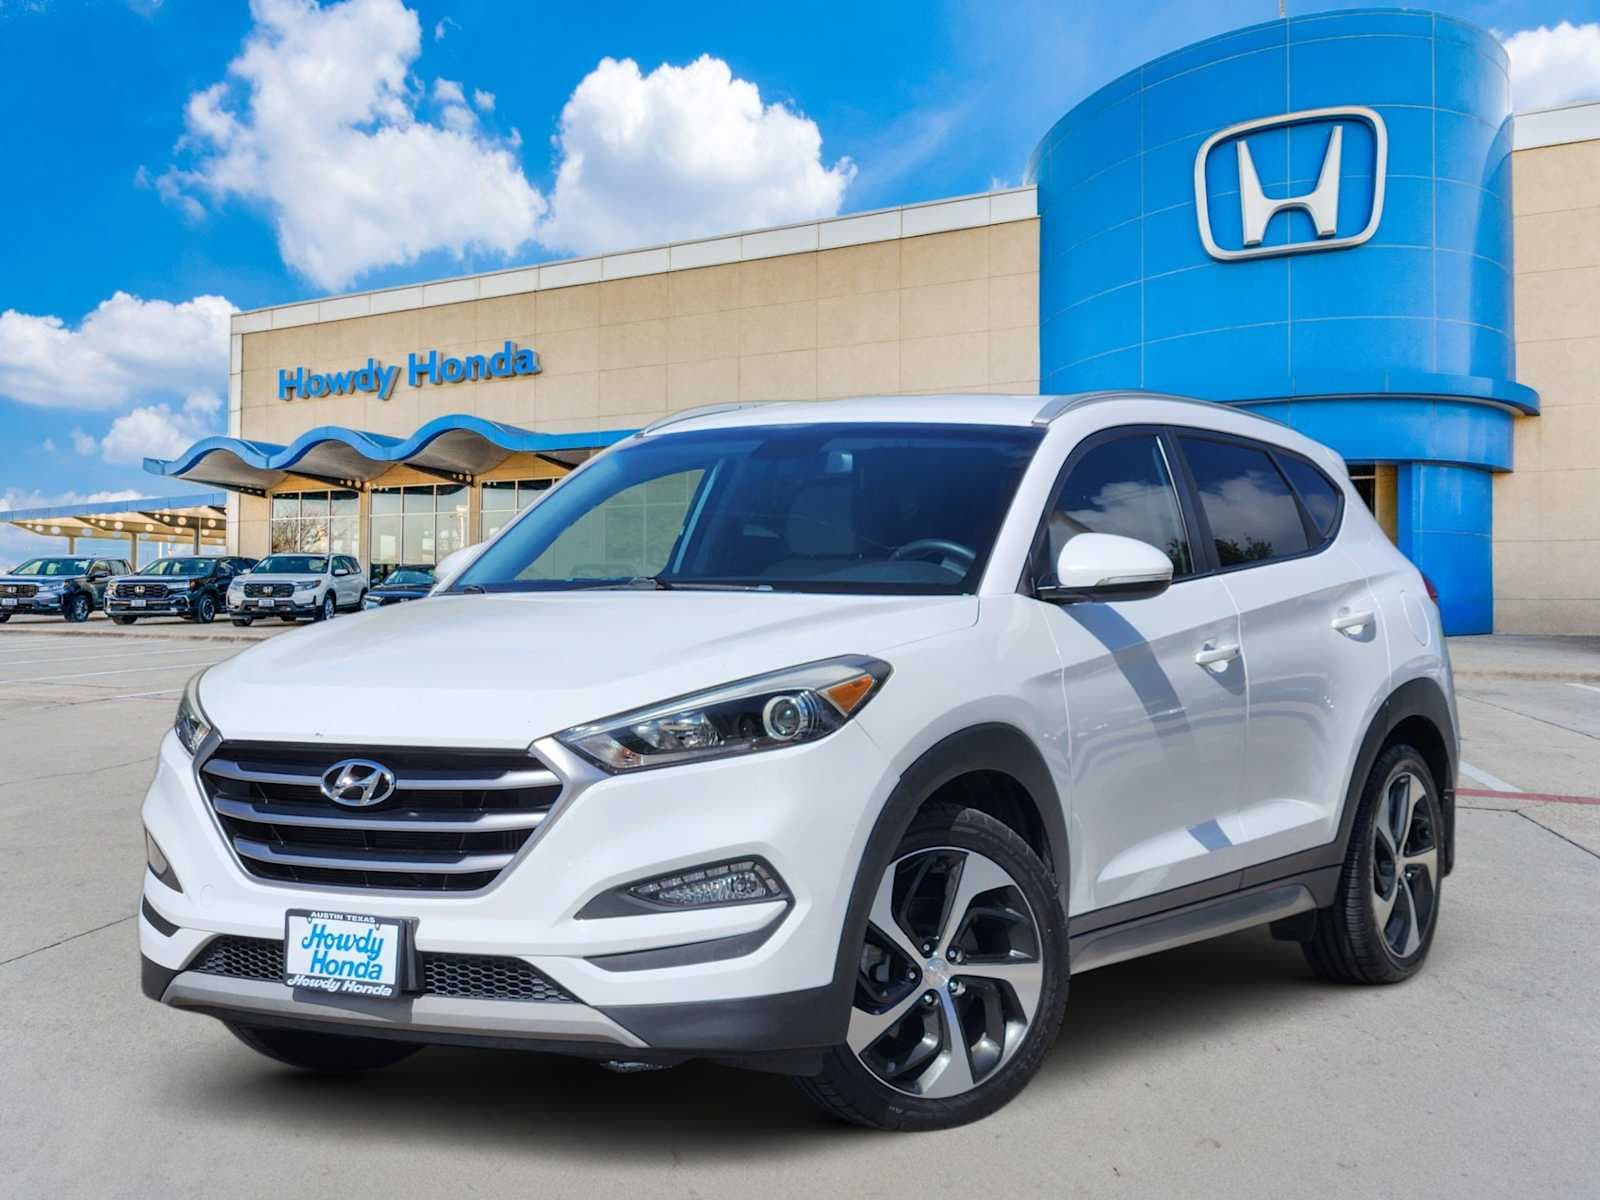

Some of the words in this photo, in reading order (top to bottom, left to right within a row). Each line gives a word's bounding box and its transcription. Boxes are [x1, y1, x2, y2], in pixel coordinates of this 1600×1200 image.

[278, 357, 400, 400] Howdy
[407, 341, 542, 387] Honda
[311, 911, 343, 920] AUSTIN
[346, 914, 376, 923] TEXAS
[301, 923, 384, 961] Howdy
[310, 950, 383, 980] Honda
[287, 975, 341, 992] Howdy
[342, 981, 392, 996] Honda
